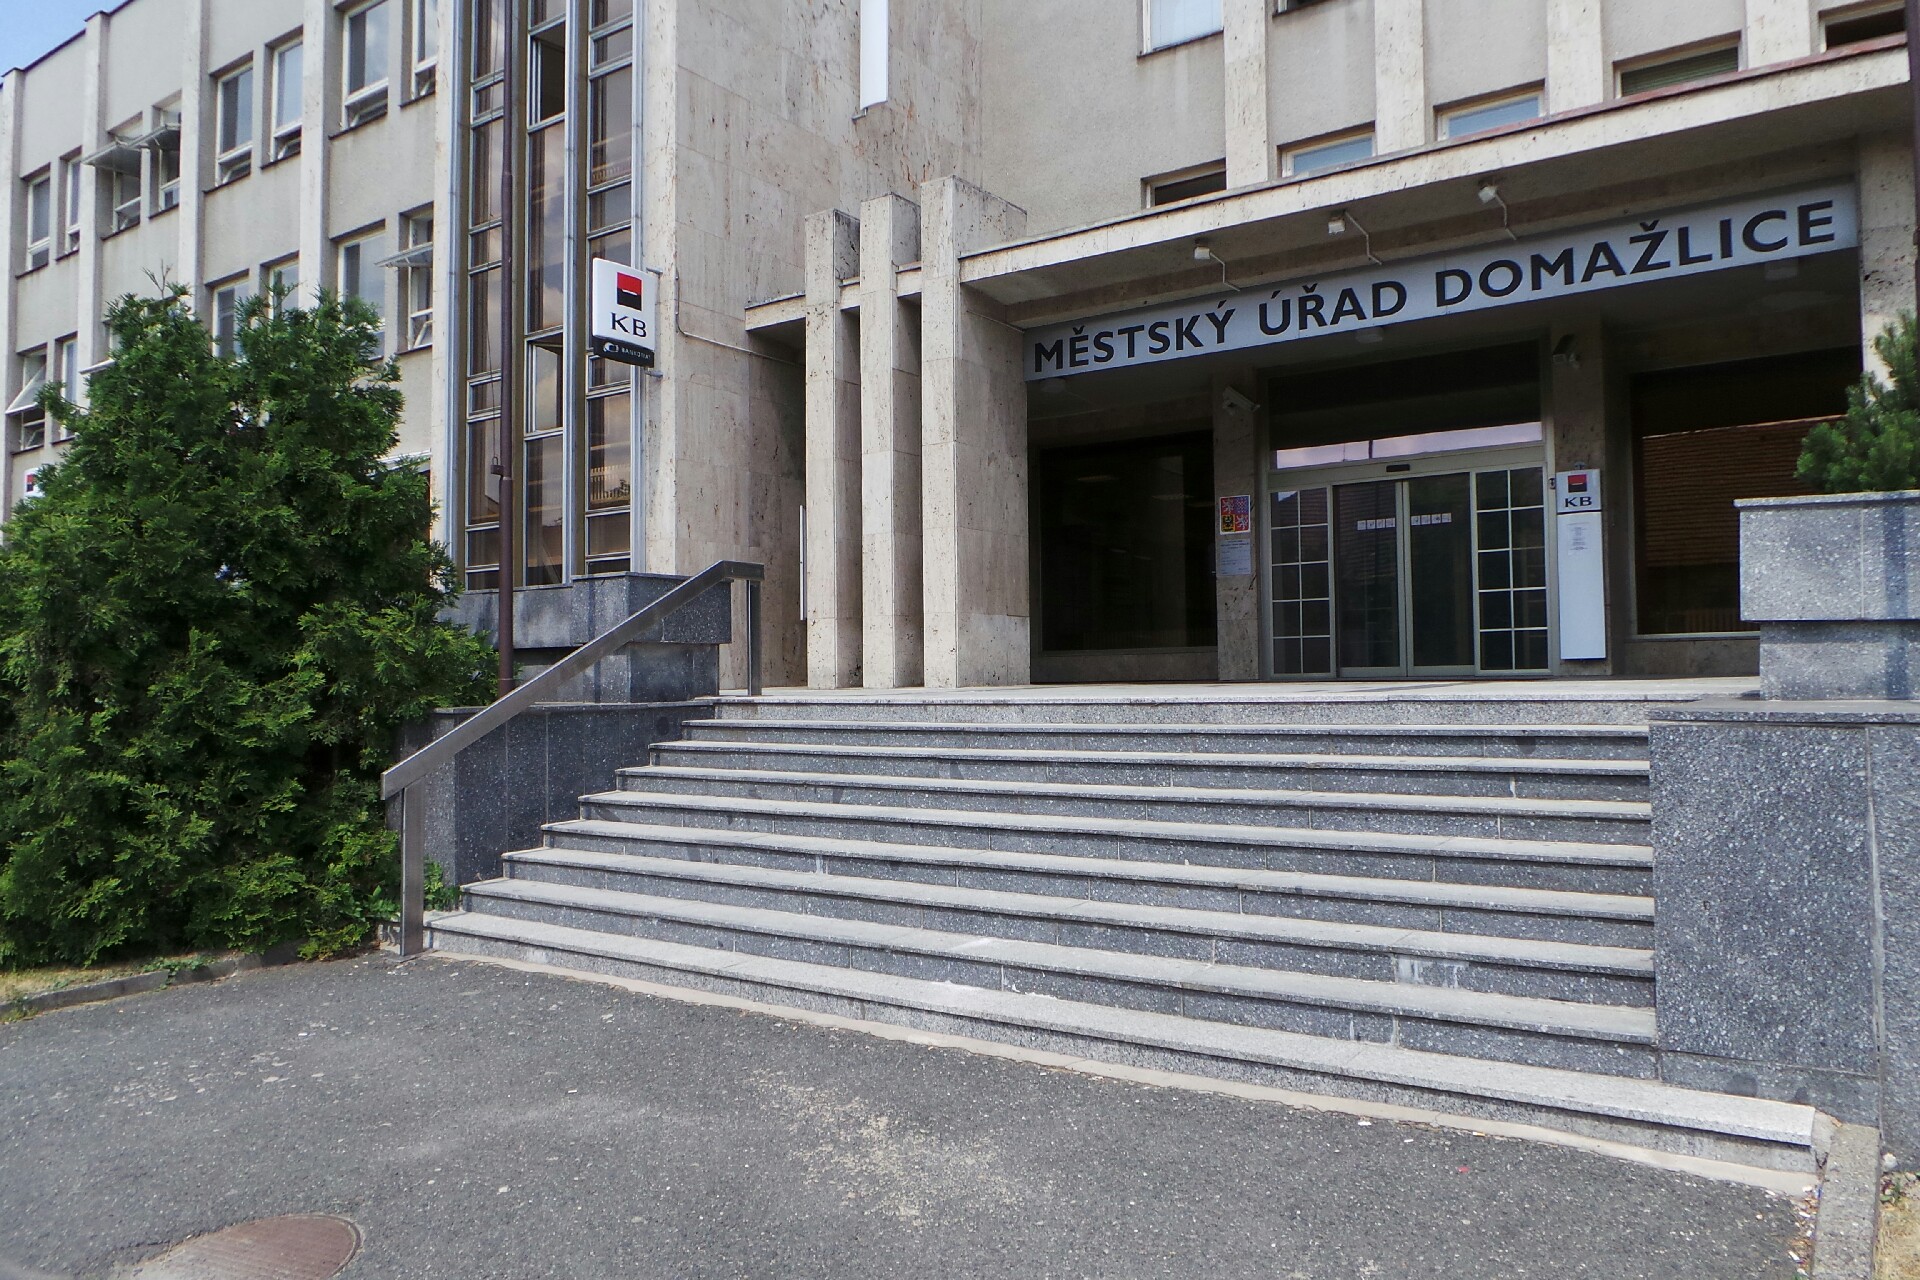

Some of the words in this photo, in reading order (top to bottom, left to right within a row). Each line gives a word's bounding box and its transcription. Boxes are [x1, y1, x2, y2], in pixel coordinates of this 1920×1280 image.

[1034, 300, 1236, 373] MĚSTSKÝ
[1258, 280, 1408, 336] ÚŘAD
[1435, 200, 1836, 308] DOMAŽLICE
[610, 312, 647, 338] KB
[1564, 496, 1593, 508] KB
